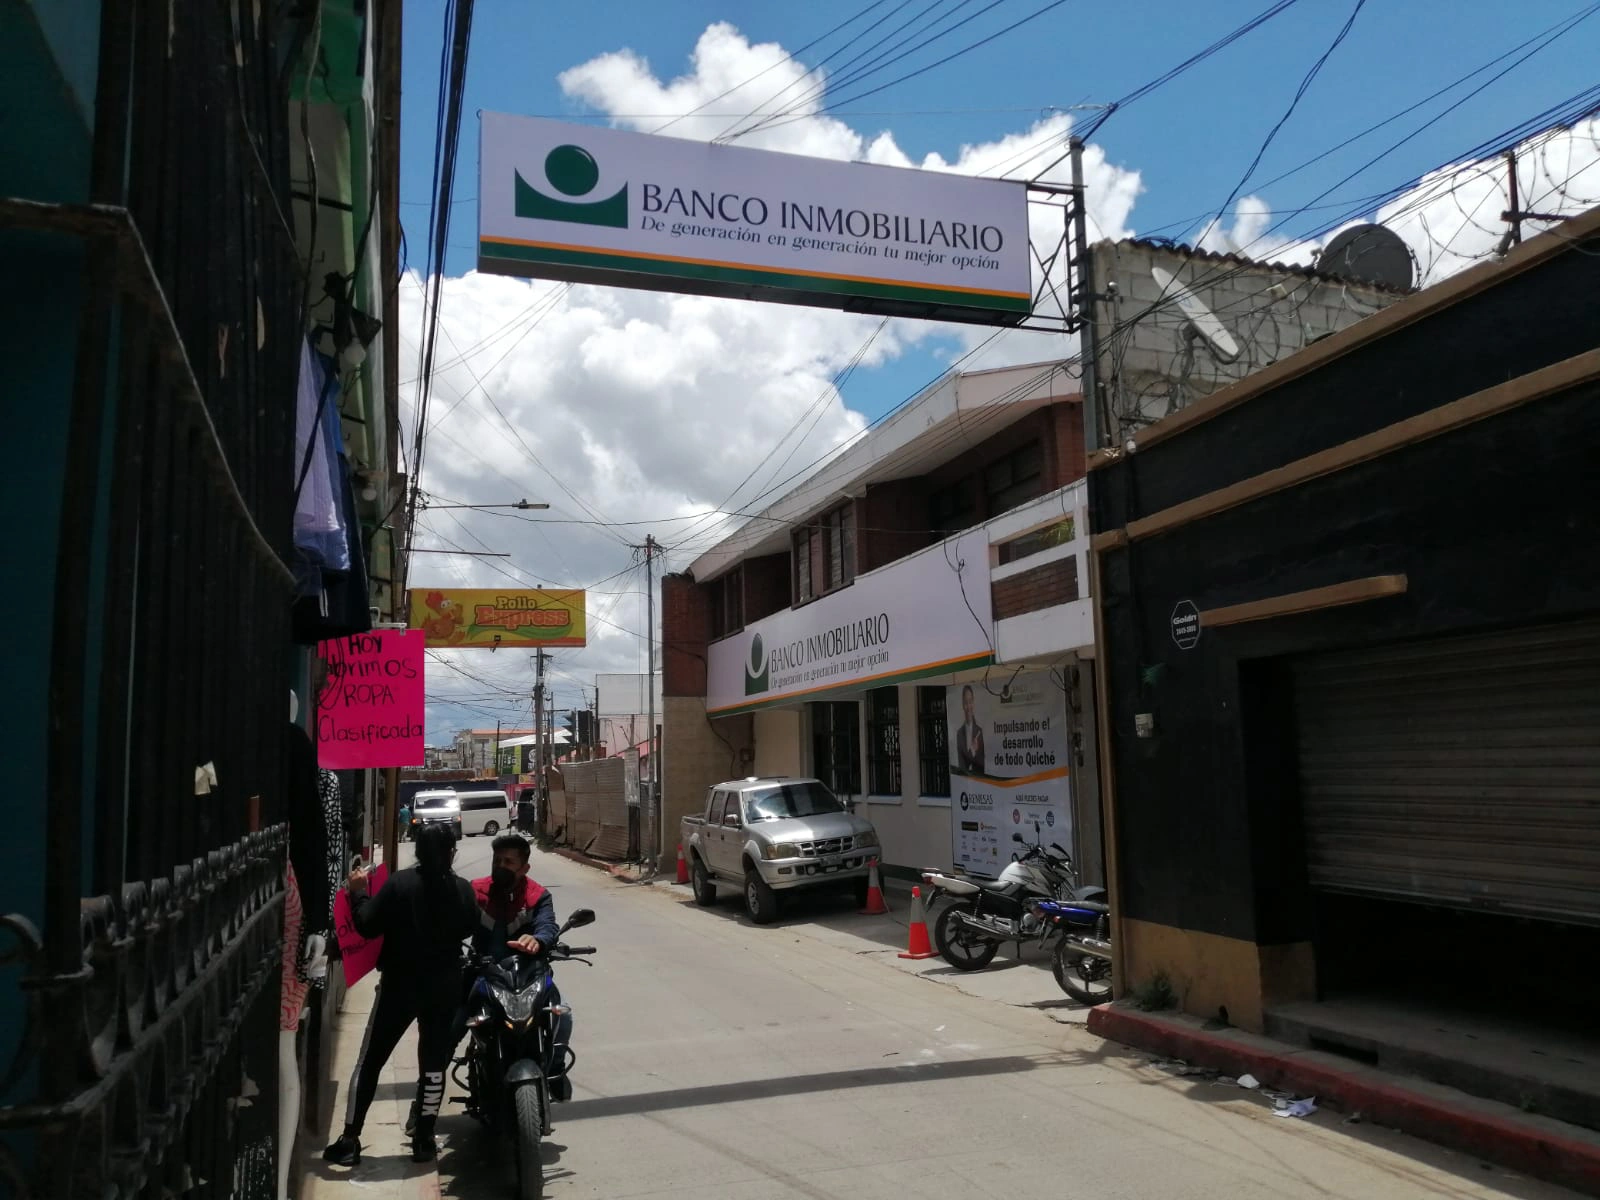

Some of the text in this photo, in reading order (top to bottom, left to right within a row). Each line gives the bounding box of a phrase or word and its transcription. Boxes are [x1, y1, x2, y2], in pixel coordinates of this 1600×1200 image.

[642, 183, 1003, 253] BANCO INMOBILIARIO
[641, 215, 1000, 270] De generación en generación tu mejor opción
[496, 596, 537, 609] Pollo
[475, 605, 570, 630] Express
[349, 635, 382, 655] HOY
[771, 613, 889, 673] BANCO INMOBILIARIO
[811, 662, 840, 681] generación
[848, 656, 865, 673] mejor
[867, 649, 889, 670] opción
[343, 683, 395, 708] ROPA
[319, 713, 423, 745] Clasificada
[994, 717, 1050, 736] Impulsando el
[1003, 735, 1044, 750] desarrollo
[995, 751, 1056, 768] de todo Quiché
[421, 1072, 443, 1116] PINK
